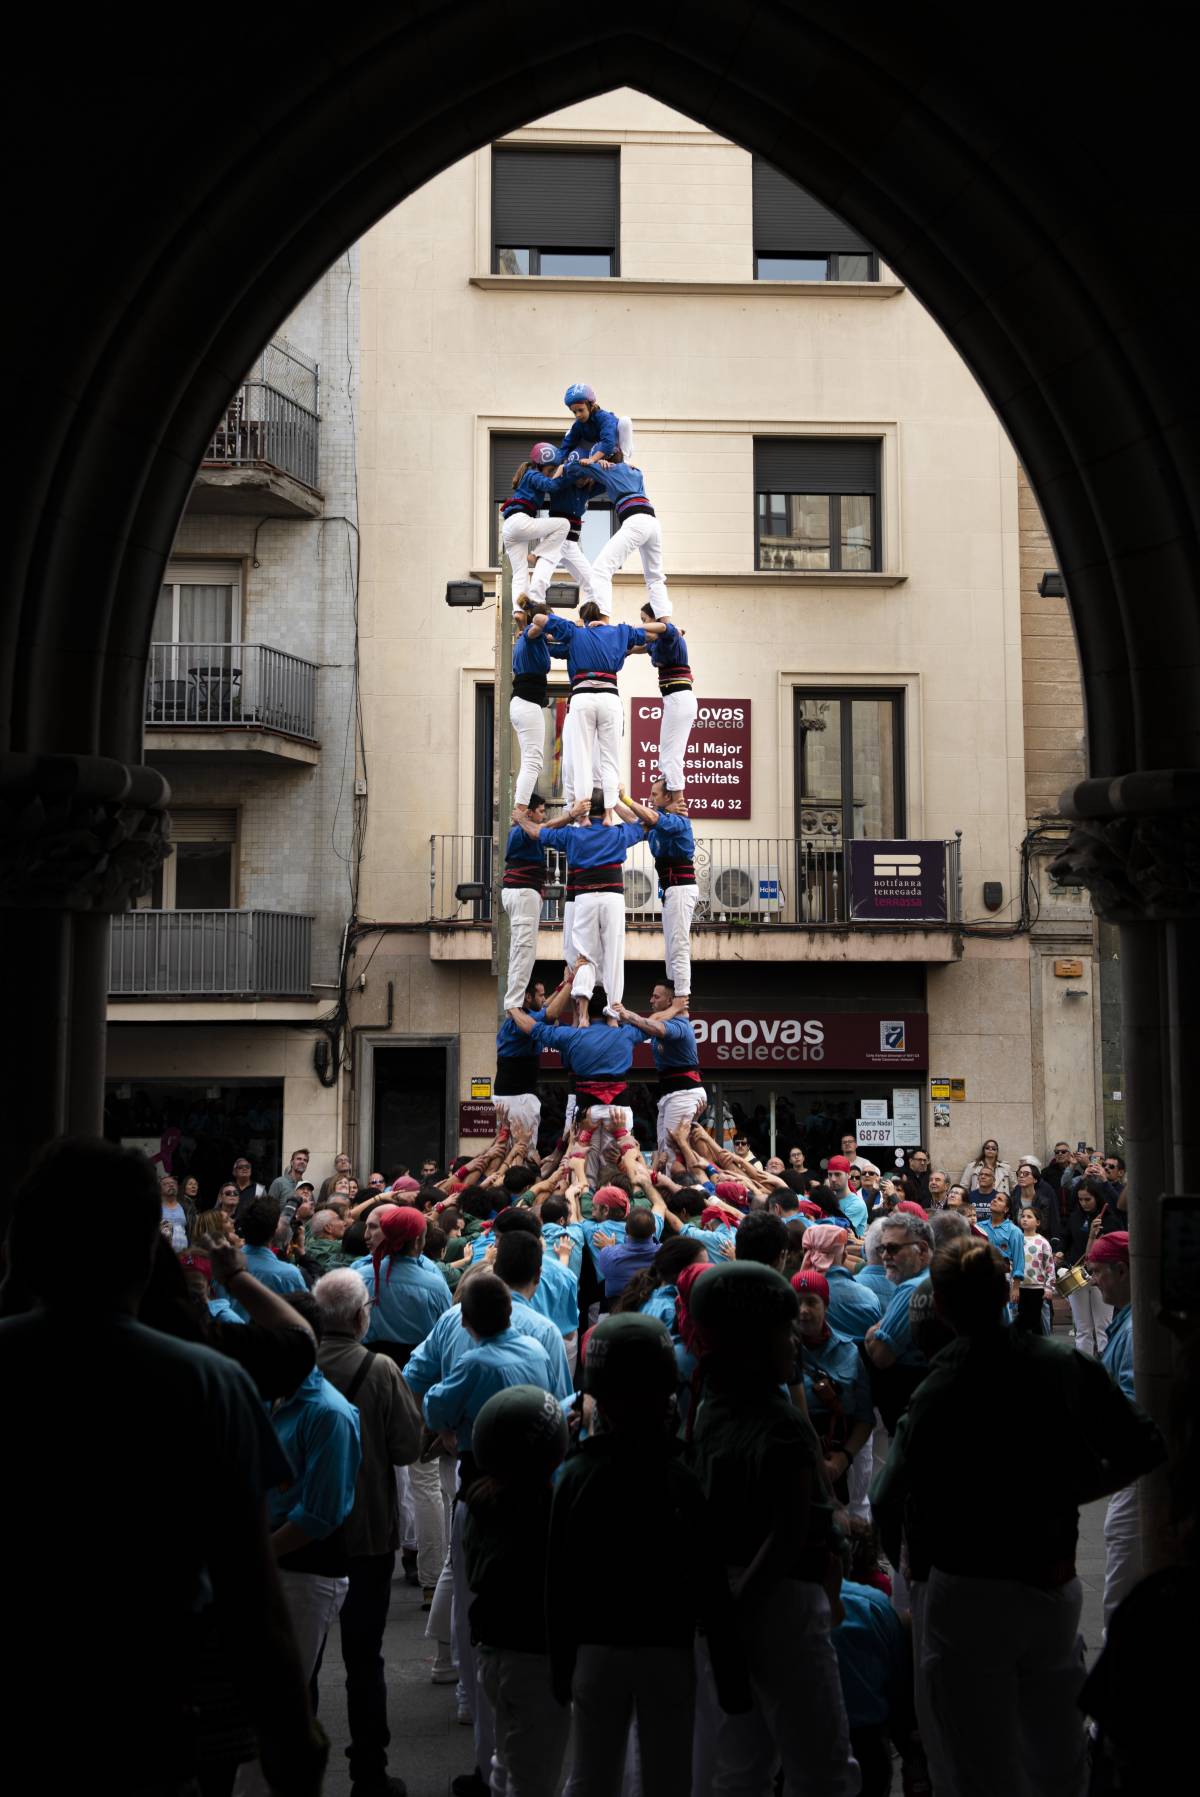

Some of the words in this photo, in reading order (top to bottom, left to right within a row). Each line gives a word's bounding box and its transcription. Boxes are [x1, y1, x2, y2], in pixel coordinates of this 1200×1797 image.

[638, 706, 744, 720] caovas
[687, 743, 699, 754] al
[703, 743, 742, 756] Major
[638, 759, 646, 768] a
[641, 772, 646, 783] i
[687, 798, 707, 809] 733
[711, 799, 725, 809] 40
[728, 799, 742, 810] 32
[688, 1019, 824, 1044] anovas
[716, 1041, 824, 1061] selecció
[859, 1129, 891, 1141] 68787
